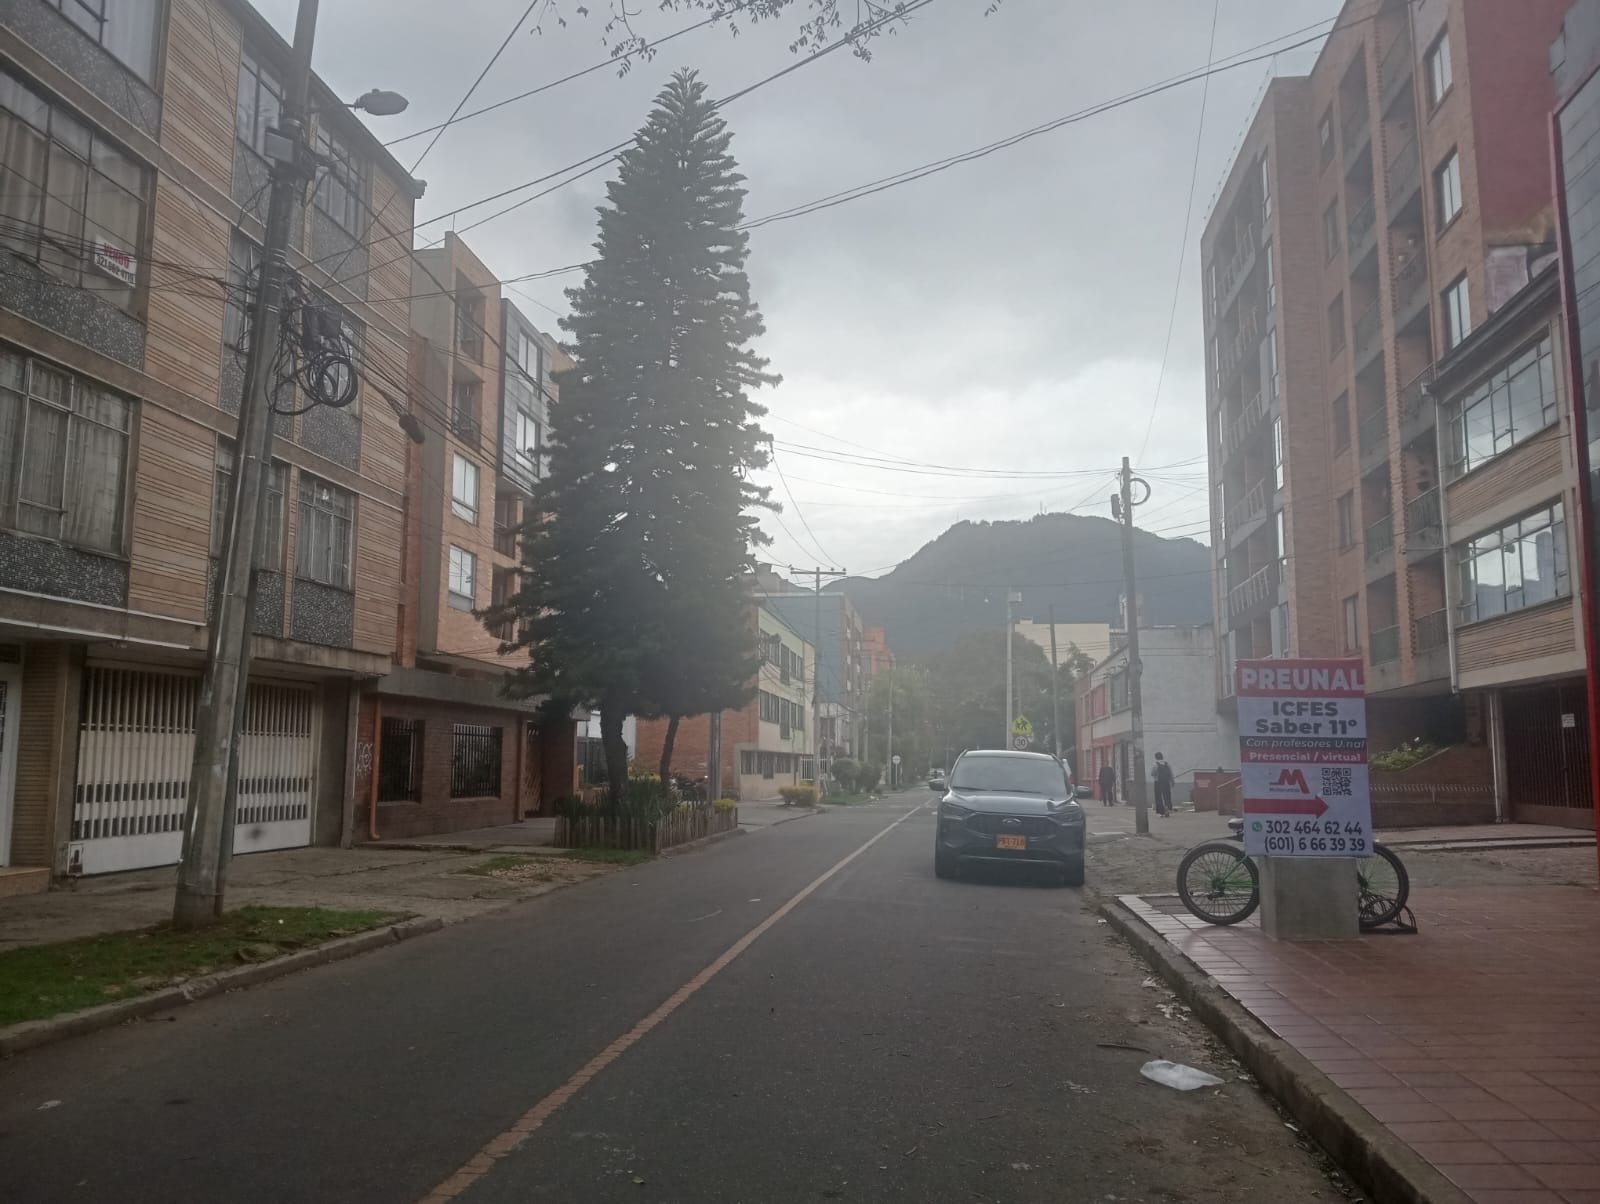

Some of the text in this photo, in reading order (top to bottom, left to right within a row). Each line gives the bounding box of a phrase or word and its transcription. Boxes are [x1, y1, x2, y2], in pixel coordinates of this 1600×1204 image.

[1241, 668, 1365, 691] PREUNAL
[1273, 701, 1338, 717] ICFES
[1255, 718, 1322, 735] Saber
[1246, 738, 1269, 748] Con
[1271, 738, 1331, 750] profesores
[1249, 752, 1310, 761] Presencial
[1322, 753, 1361, 762] virtual
[1265, 820, 1362, 835] 302 464 62 44
[1264, 837, 1365, 852] (601) 6 66 39 39
